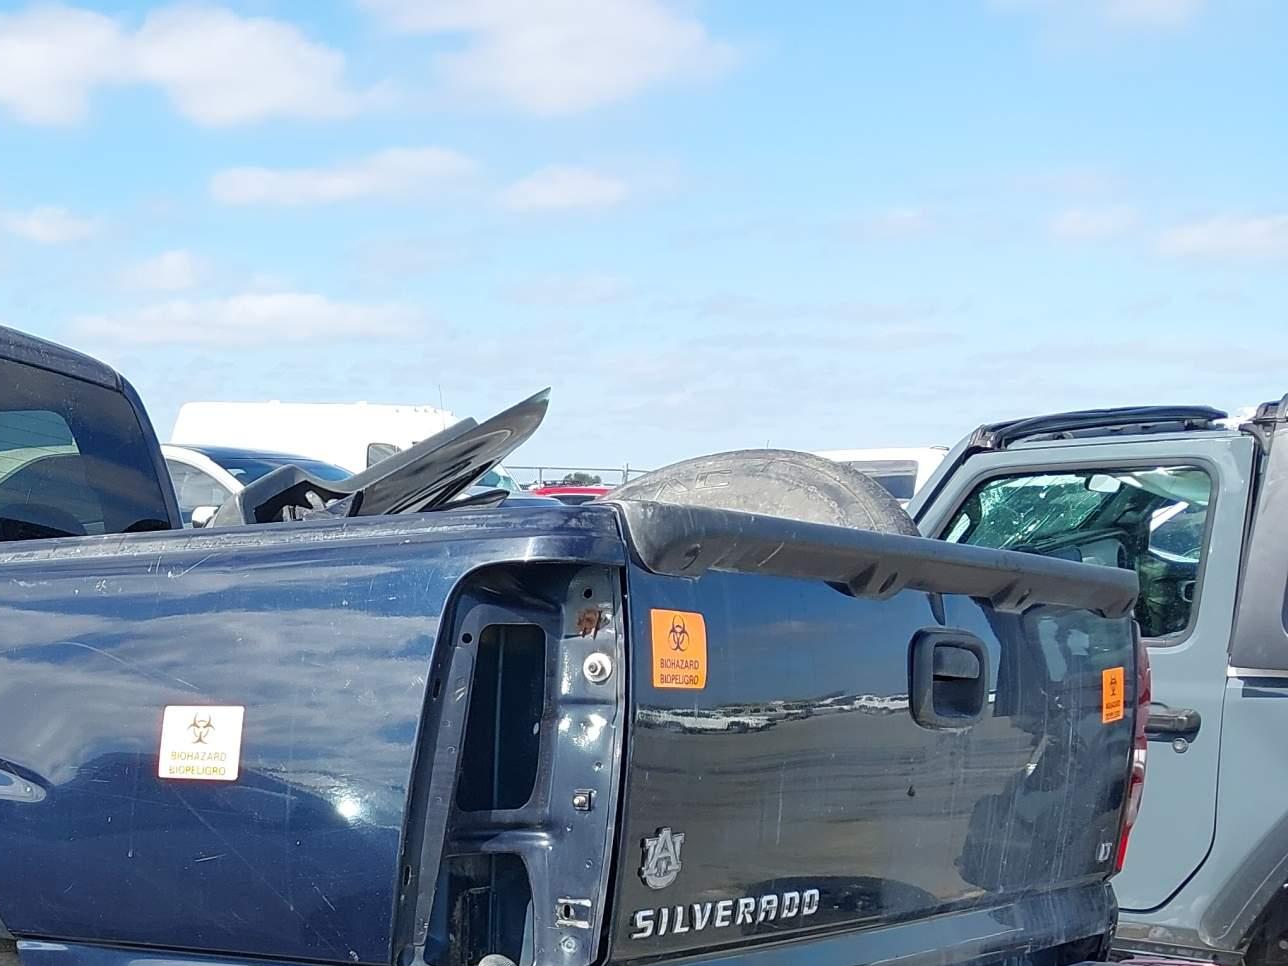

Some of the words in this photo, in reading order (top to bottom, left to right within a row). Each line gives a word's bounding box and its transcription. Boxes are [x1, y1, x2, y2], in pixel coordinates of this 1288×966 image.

[659, 658, 700, 670] BIOHAZARD
[659, 673, 700, 686] BIOPELIGRO
[170, 751, 227, 762] BIOHAZARD
[168, 764, 226, 776] BIOPELIGRO
[630, 888, 820, 940] SILVERADO
